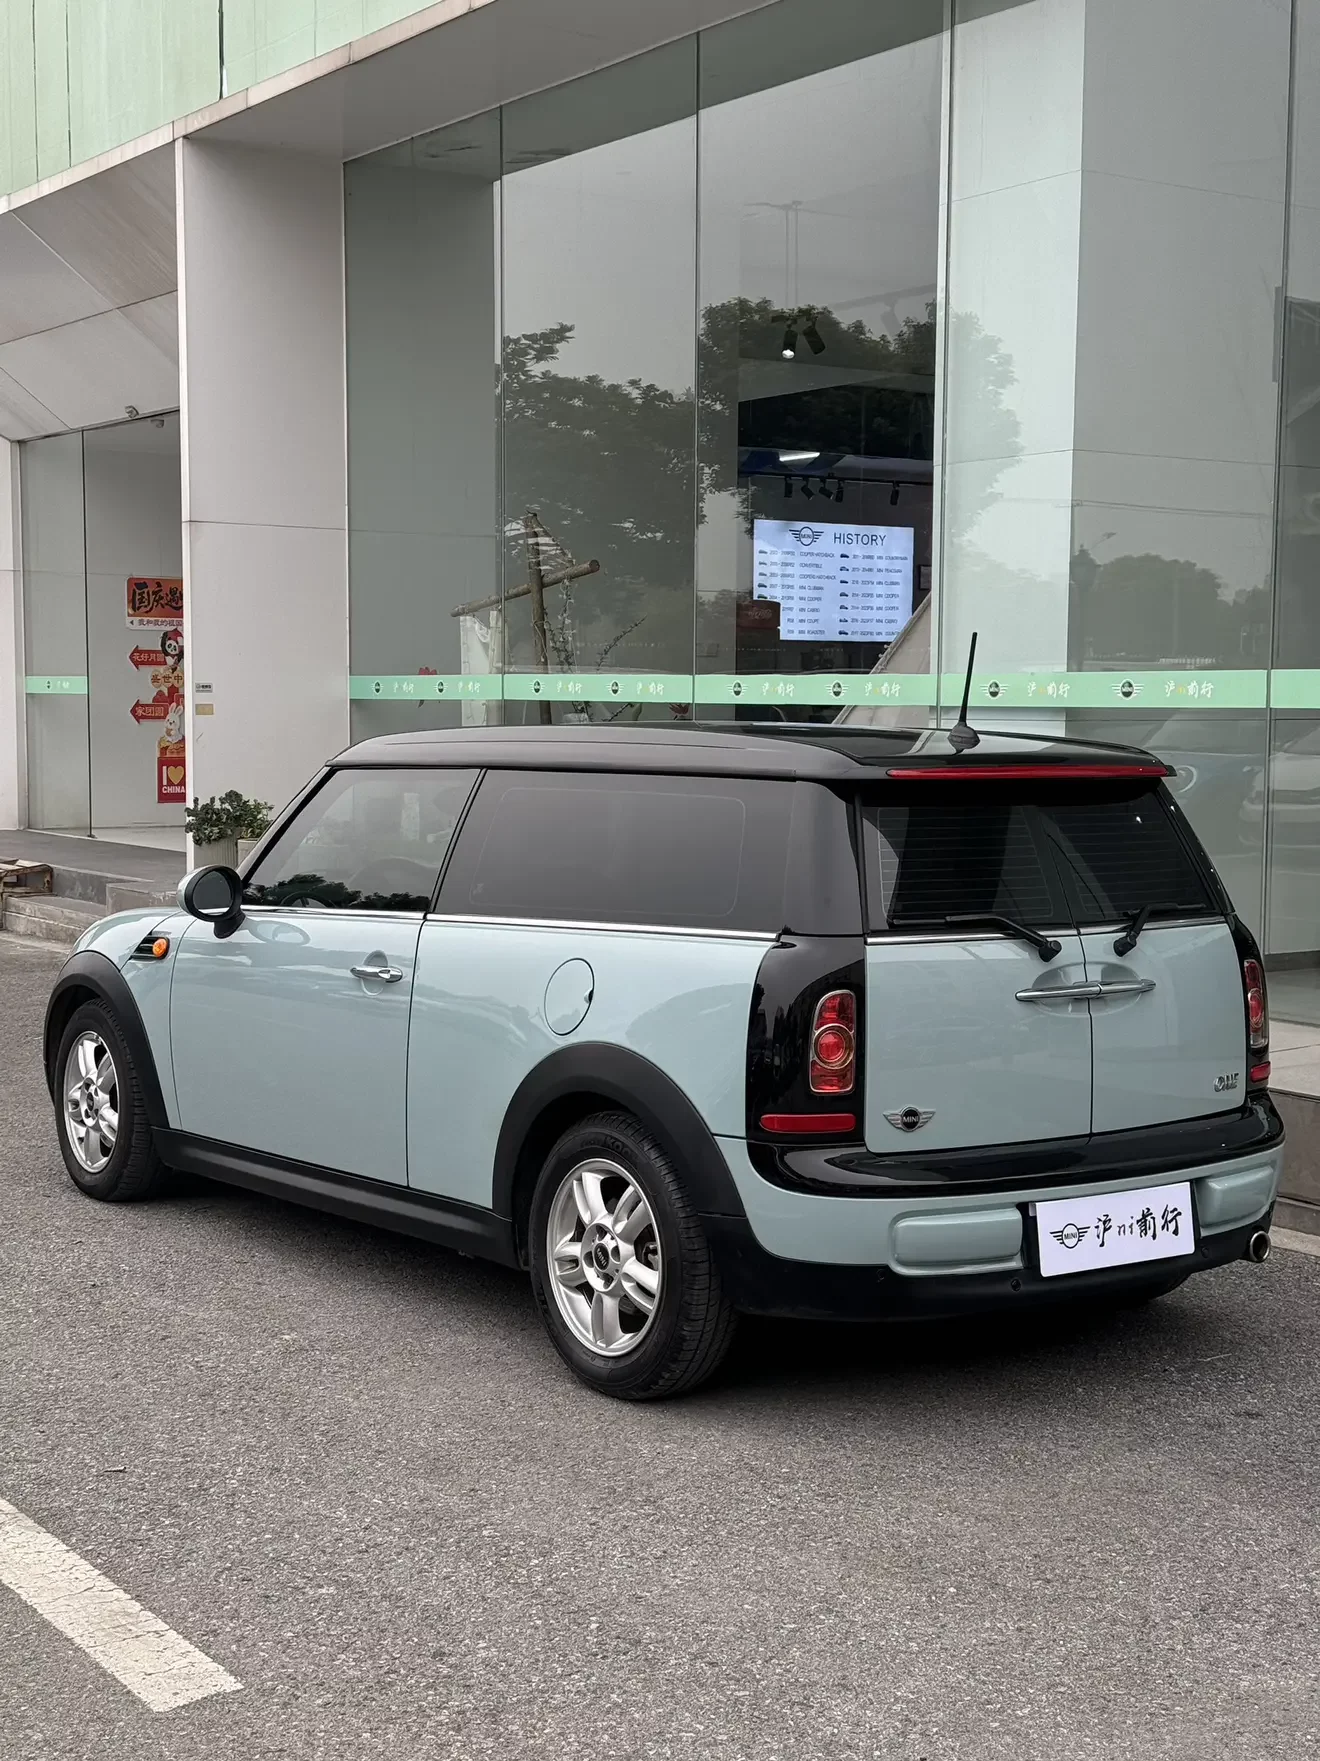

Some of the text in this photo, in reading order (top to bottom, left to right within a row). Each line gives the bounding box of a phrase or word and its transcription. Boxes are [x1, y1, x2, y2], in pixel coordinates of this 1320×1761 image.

[833, 532, 886, 546] HISTORY
[162, 765, 167, 785] I
[162, 786, 185, 794] CHINA
[903, 1115, 919, 1123] MINI
[1064, 1231, 1078, 1240] MINI
[596, 1247, 608, 1267] MINI
